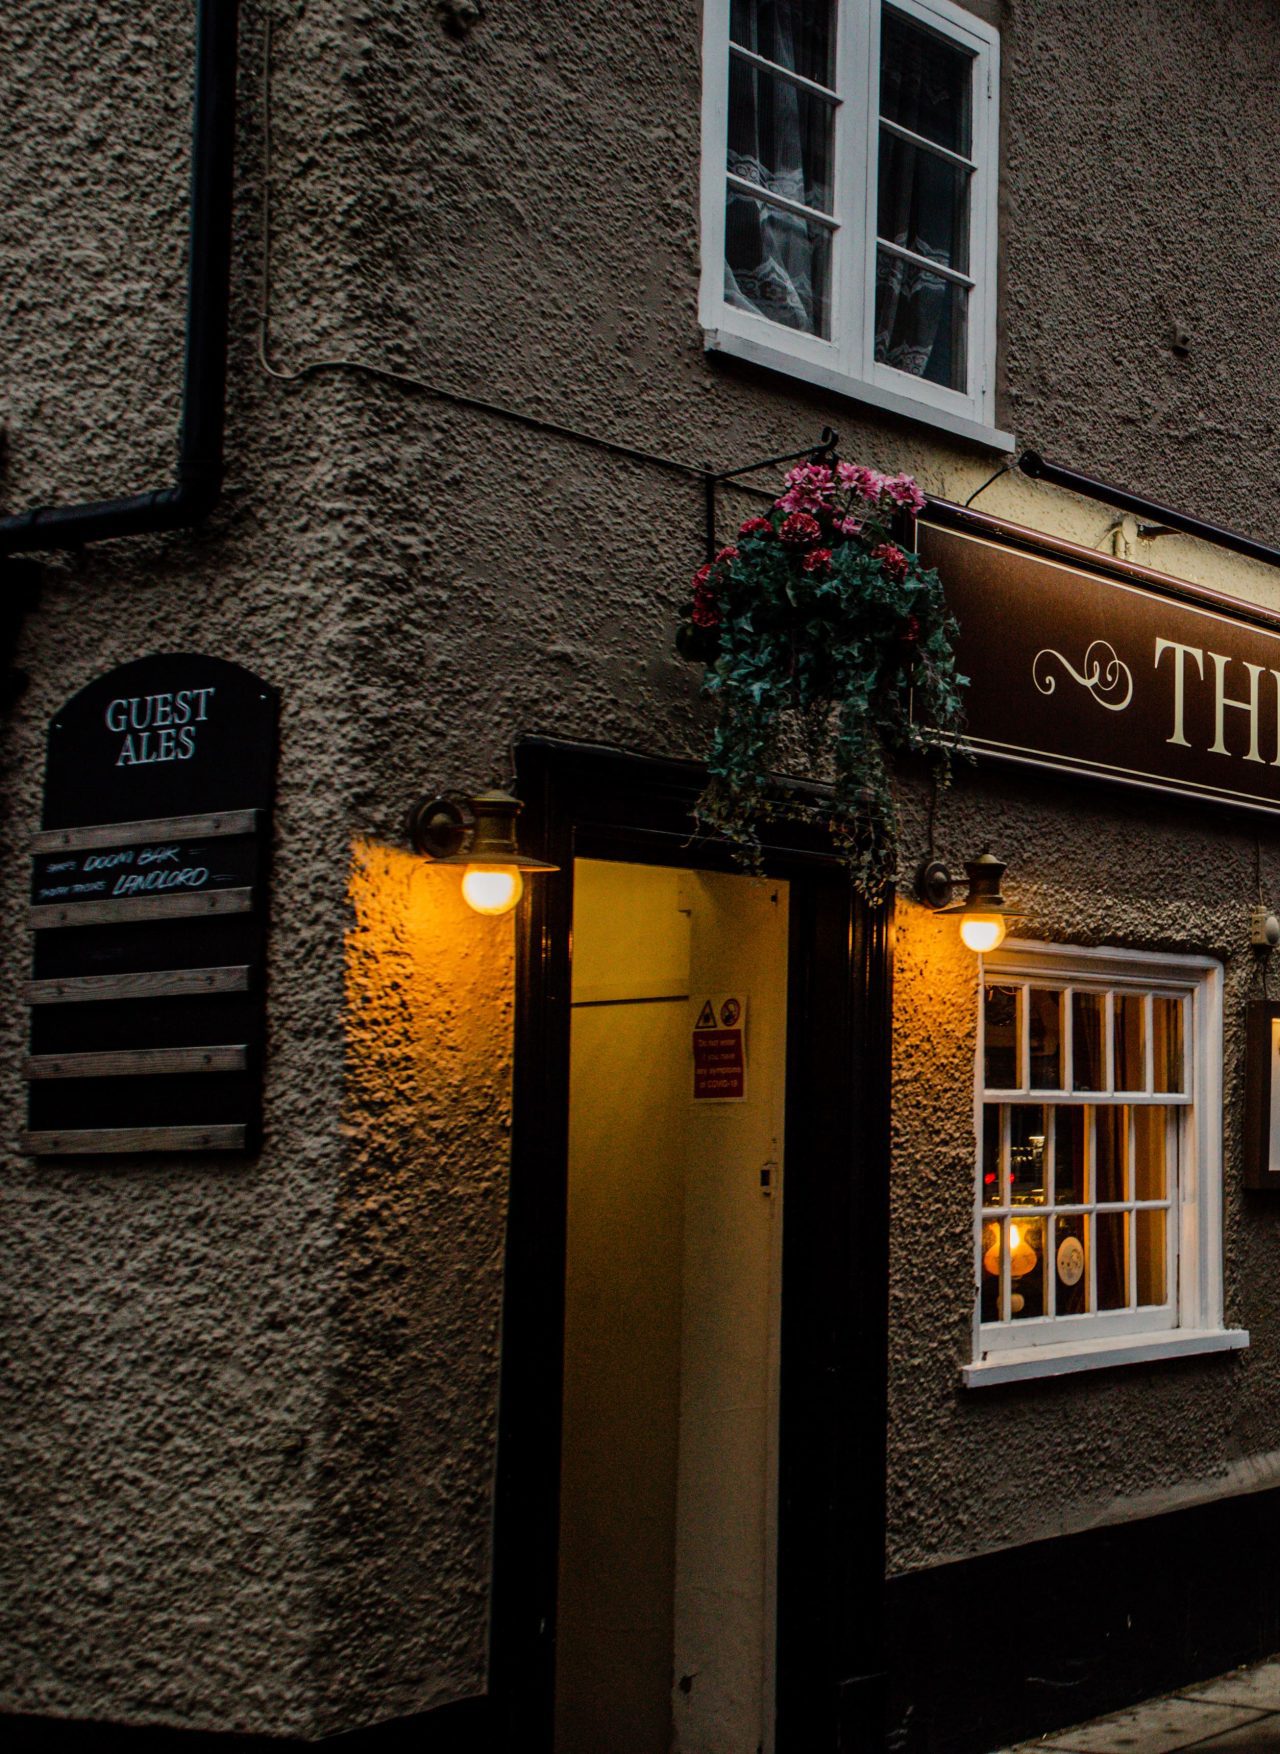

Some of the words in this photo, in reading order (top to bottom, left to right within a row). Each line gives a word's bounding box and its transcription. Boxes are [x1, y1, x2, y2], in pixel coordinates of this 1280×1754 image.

[104, 687, 216, 732] GUEST
[115, 726, 196, 766] ALES
[83, 851, 134, 871] DOOM
[137, 846, 180, 866] BAR
[112, 867, 209, 896] LANDLORD
